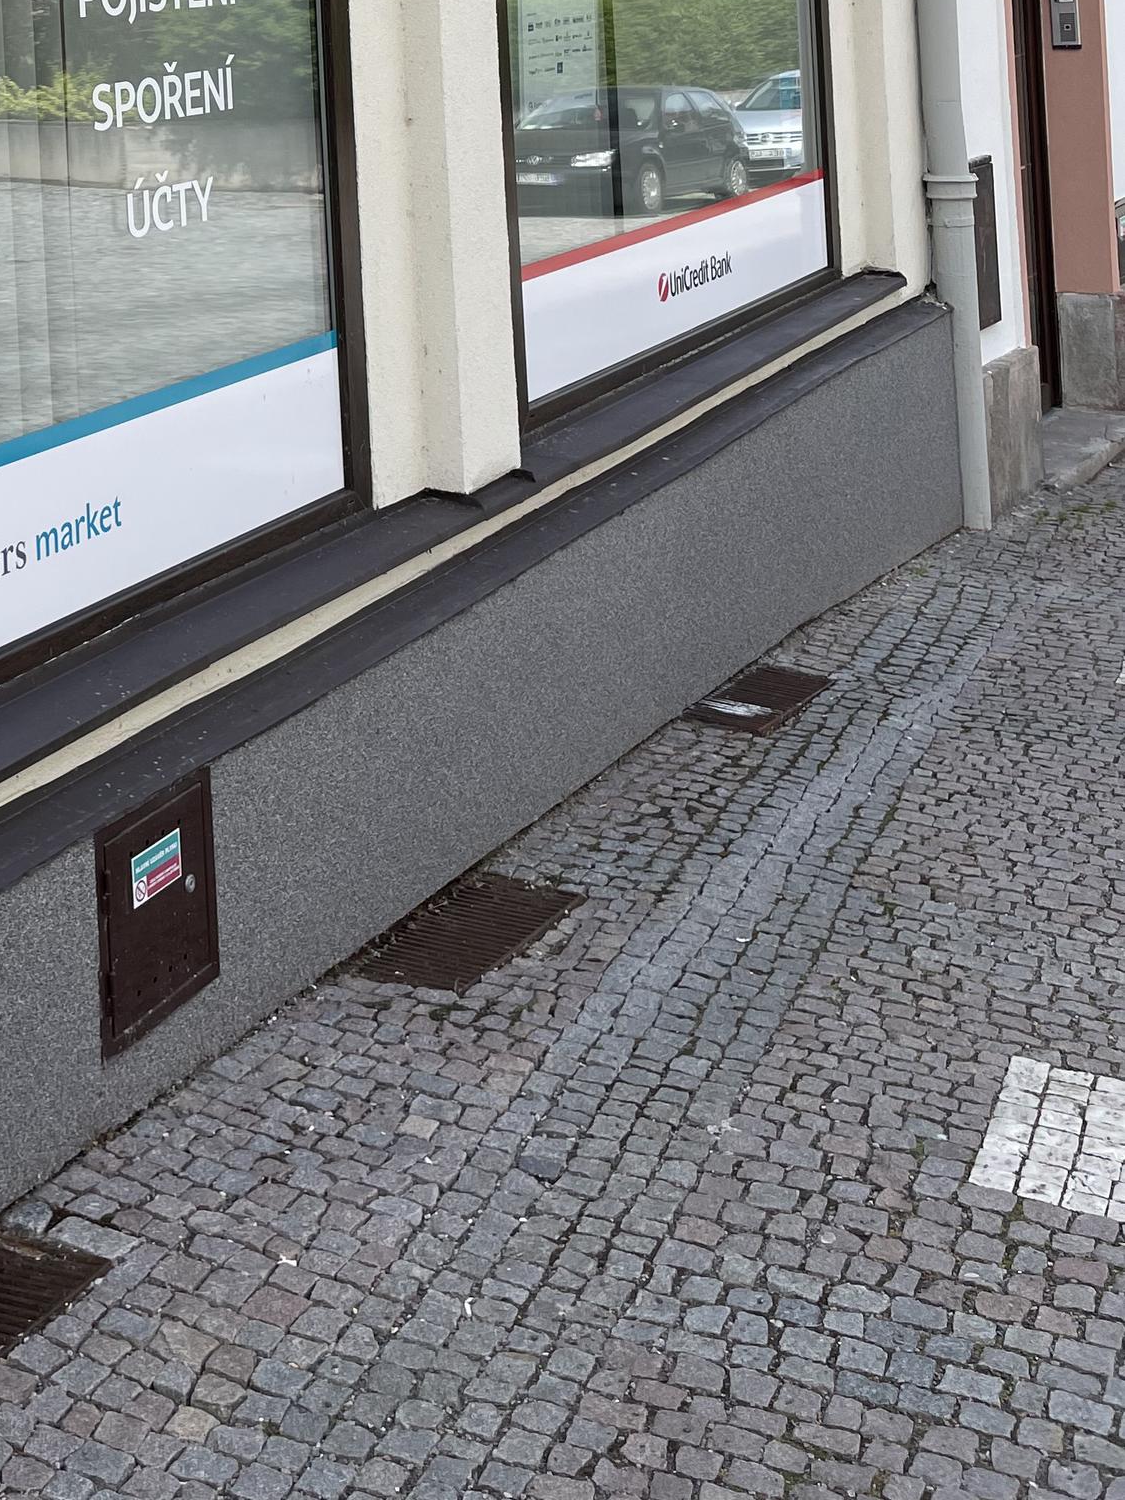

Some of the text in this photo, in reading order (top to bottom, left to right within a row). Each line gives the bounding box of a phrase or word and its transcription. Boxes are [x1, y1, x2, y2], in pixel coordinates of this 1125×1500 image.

[92, 54, 234, 131] SPOŘENÍ
[126, 169, 214, 238] ÚČTY
[669, 250, 732, 297] UniCredit Bank
[35, 496, 122, 561] market
